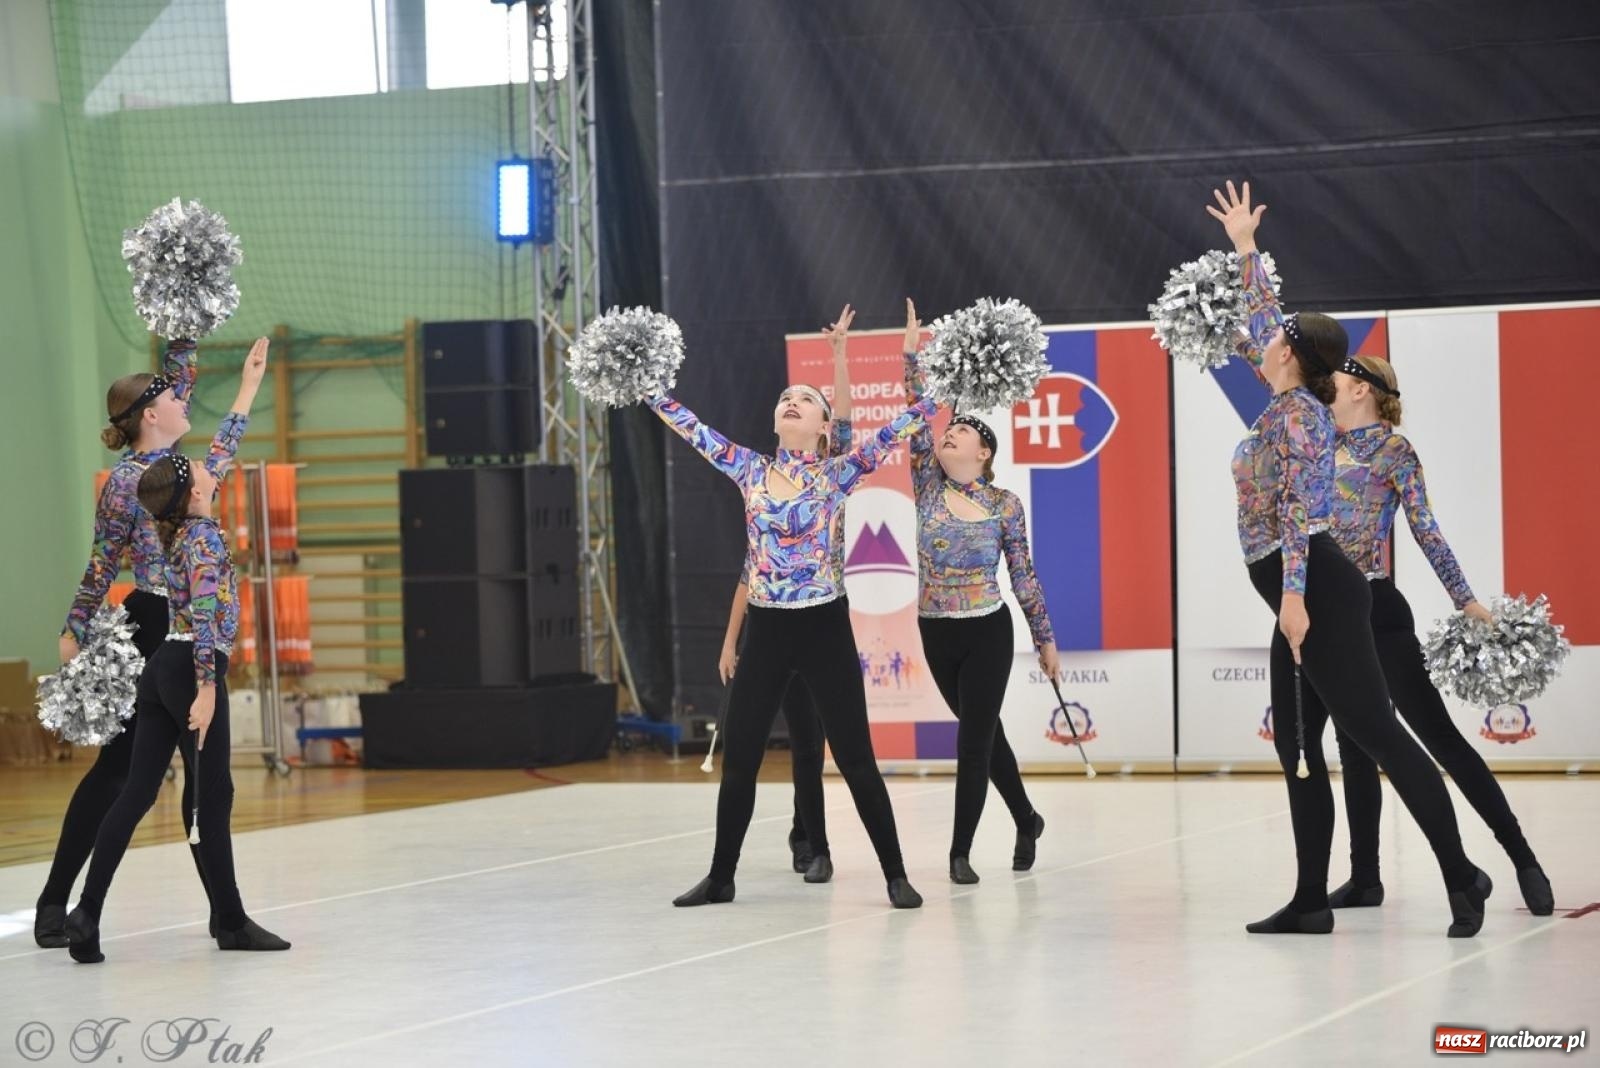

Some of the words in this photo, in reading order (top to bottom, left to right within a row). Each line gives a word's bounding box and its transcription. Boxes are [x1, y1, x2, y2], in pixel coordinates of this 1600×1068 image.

[821, 382, 905, 401] EROPEA
[1029, 670, 1109, 684] SLVAKIA
[1212, 668, 1266, 681] CZECH
